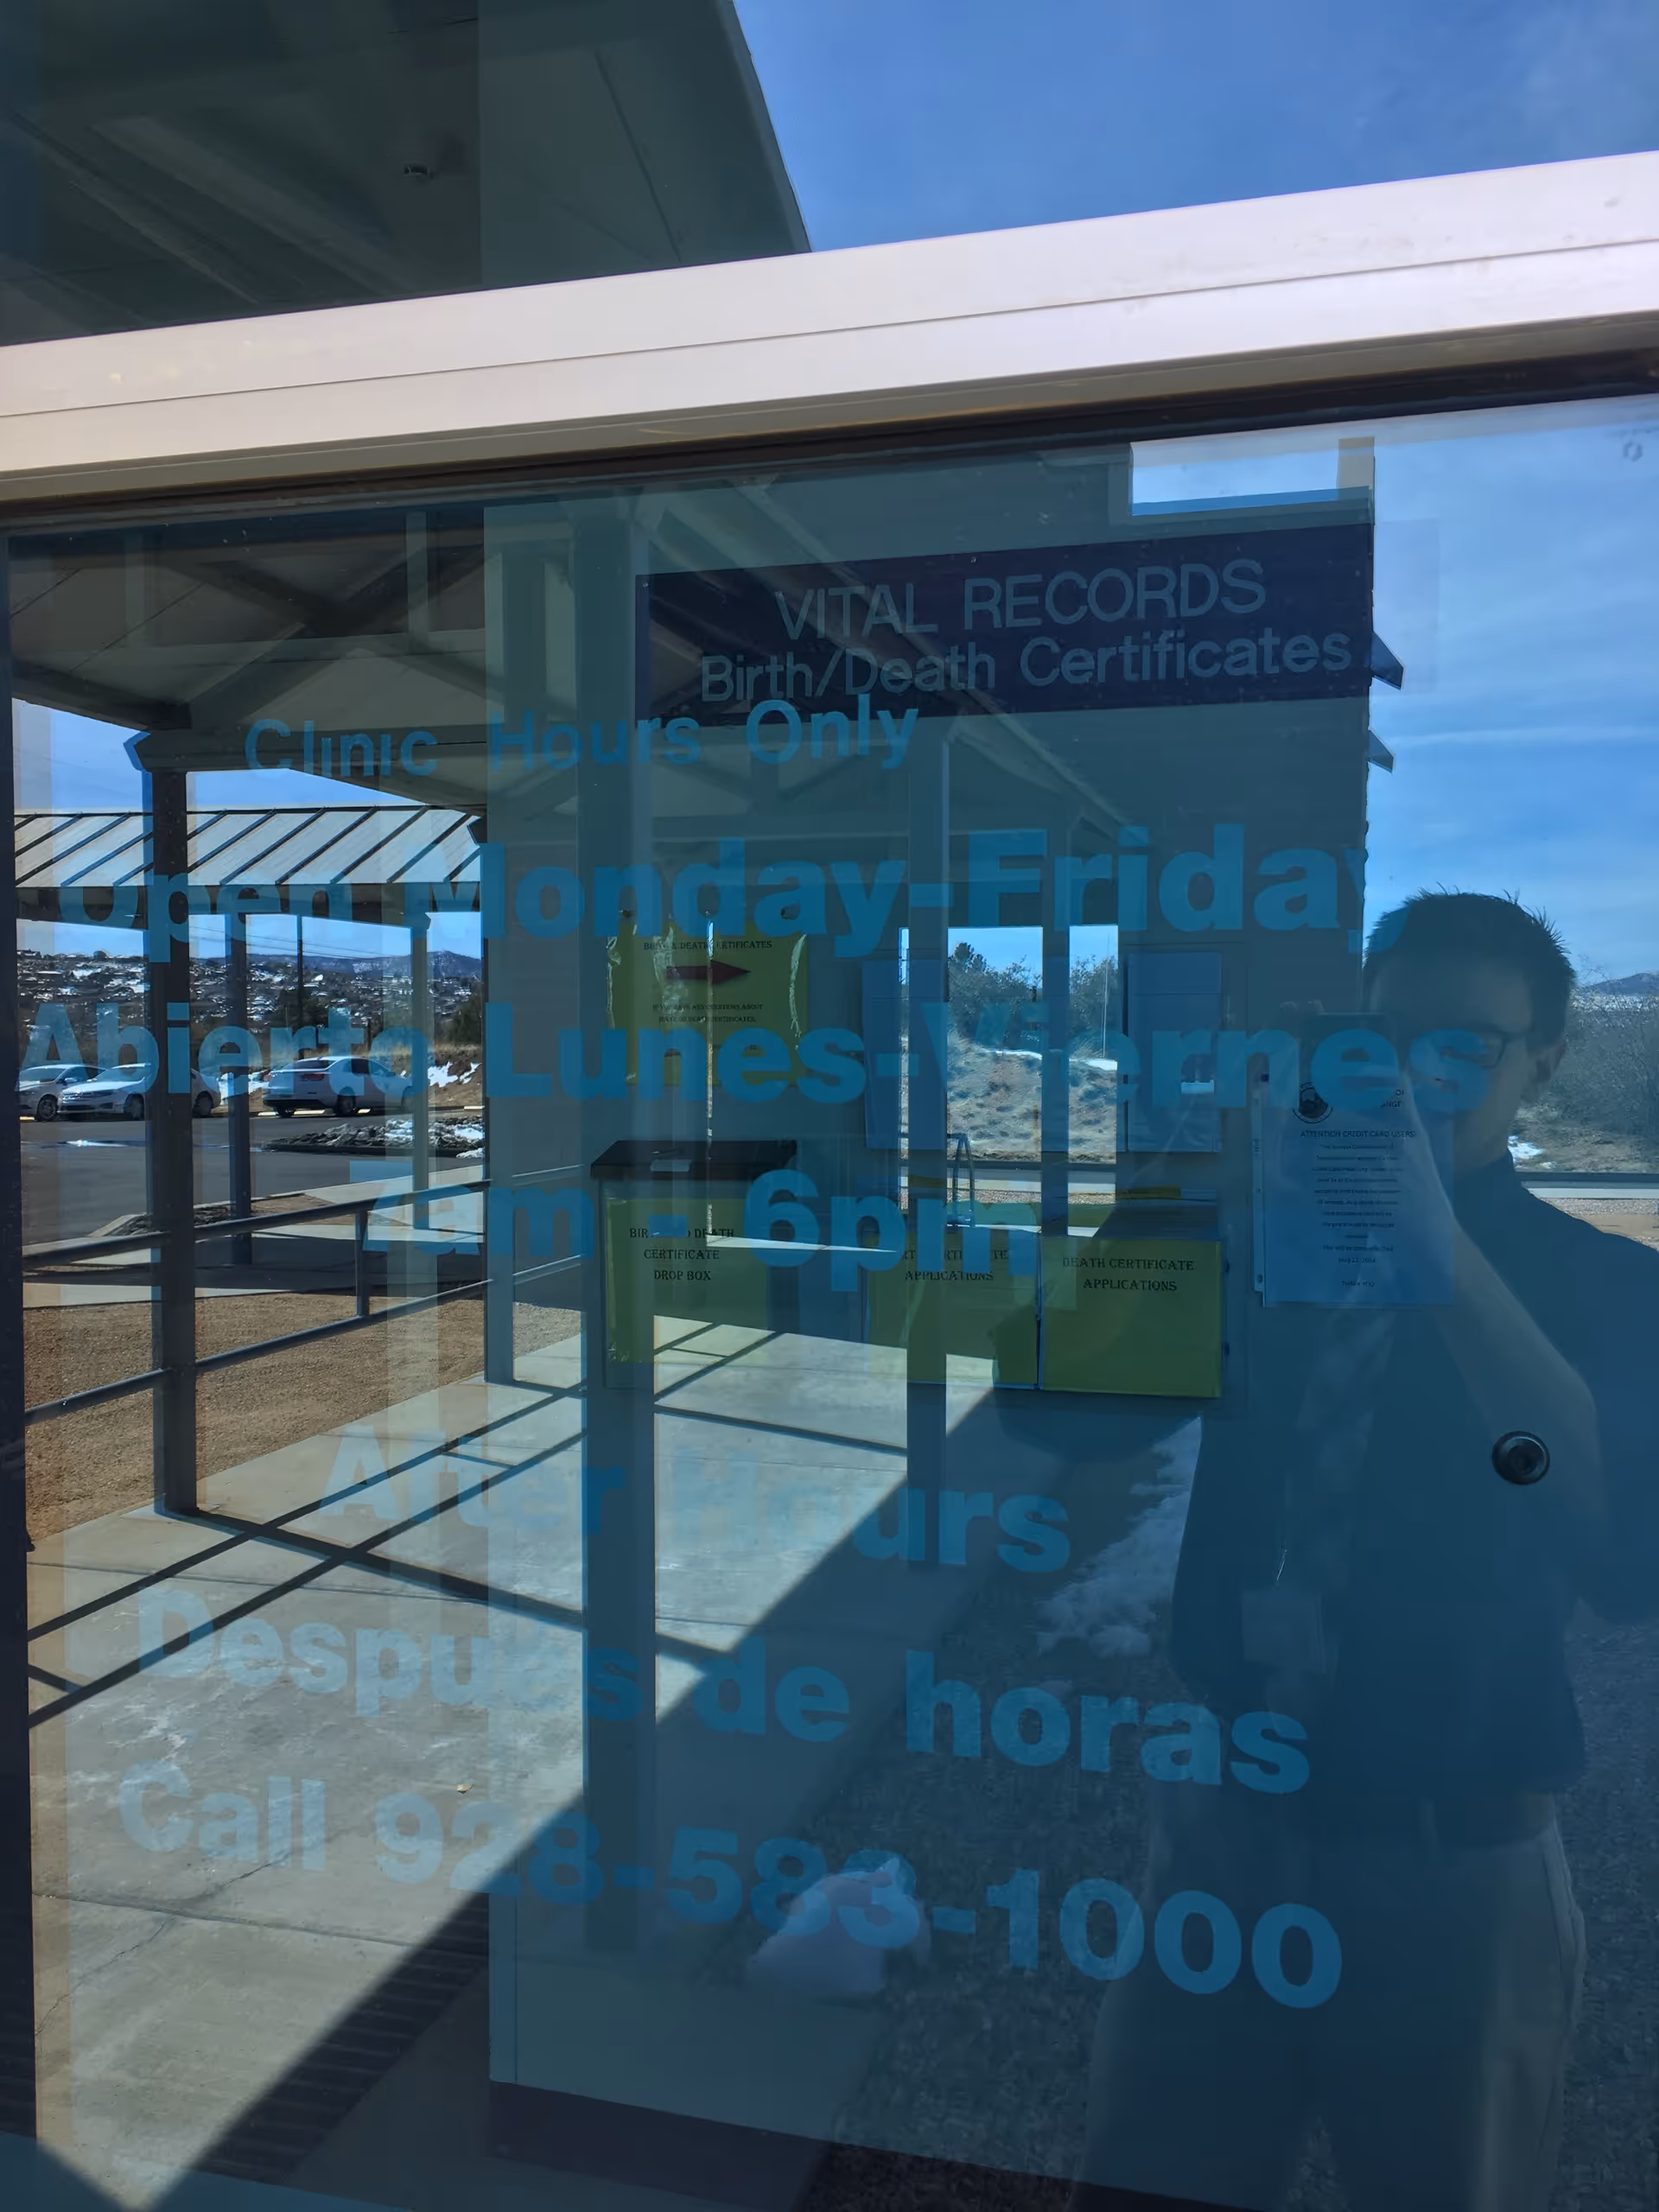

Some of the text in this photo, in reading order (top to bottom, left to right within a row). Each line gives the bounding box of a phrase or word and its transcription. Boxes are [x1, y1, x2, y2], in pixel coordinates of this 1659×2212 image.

[772, 556, 1268, 640] VITAL RECORDS
[701, 624, 1353, 702] Birth/Death Certificates
[244, 694, 919, 777] Clinic Hours Only
[14, 1001, 429, 1098] Abierto
[349, 1160, 596, 1260] 7am
[741, 1168, 1037, 1293] 6pm
[644, 1249, 720, 1260] CERTIFICATE
[1062, 1256, 1195, 1272] DEATH CERTIFICATE
[654, 1269, 712, 1281] DROP BOX
[1083, 1278, 1178, 1292] APPLICATIONS
[695, 1636, 851, 1744] de
[905, 1649, 1311, 1795] horas
[118, 1758, 1344, 2010] Call 928-583-1000
